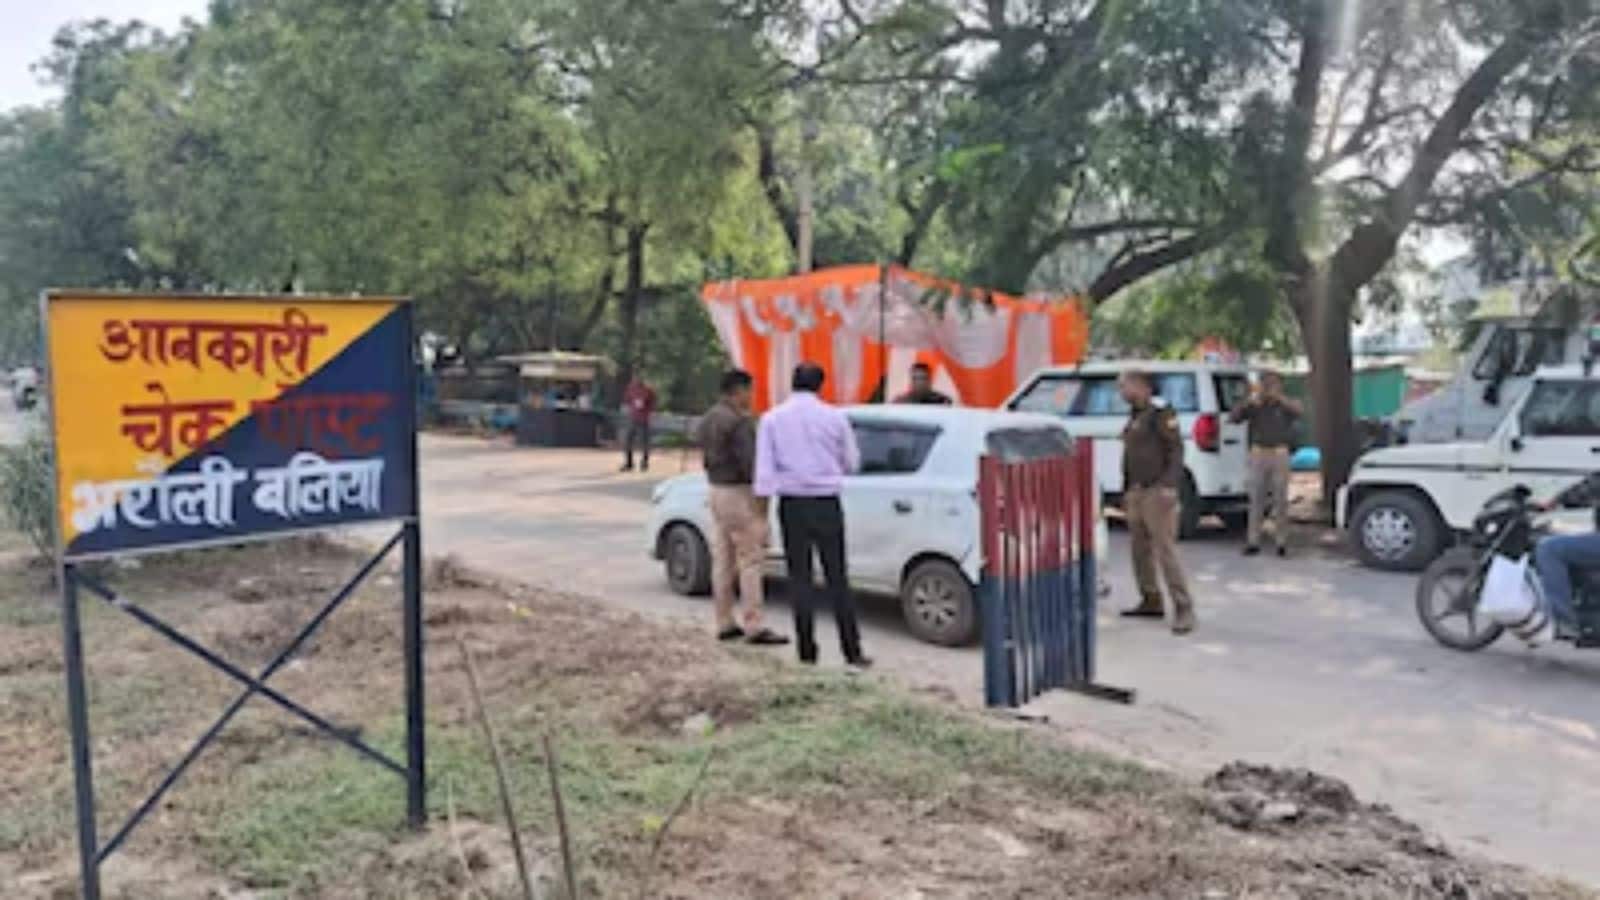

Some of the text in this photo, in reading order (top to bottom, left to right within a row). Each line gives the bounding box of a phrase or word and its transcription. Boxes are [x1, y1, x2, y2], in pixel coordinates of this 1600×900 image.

[100, 308, 328, 377] आबकारी
[121, 381, 235, 457] चेक
[253, 451, 385, 518] बलिया
